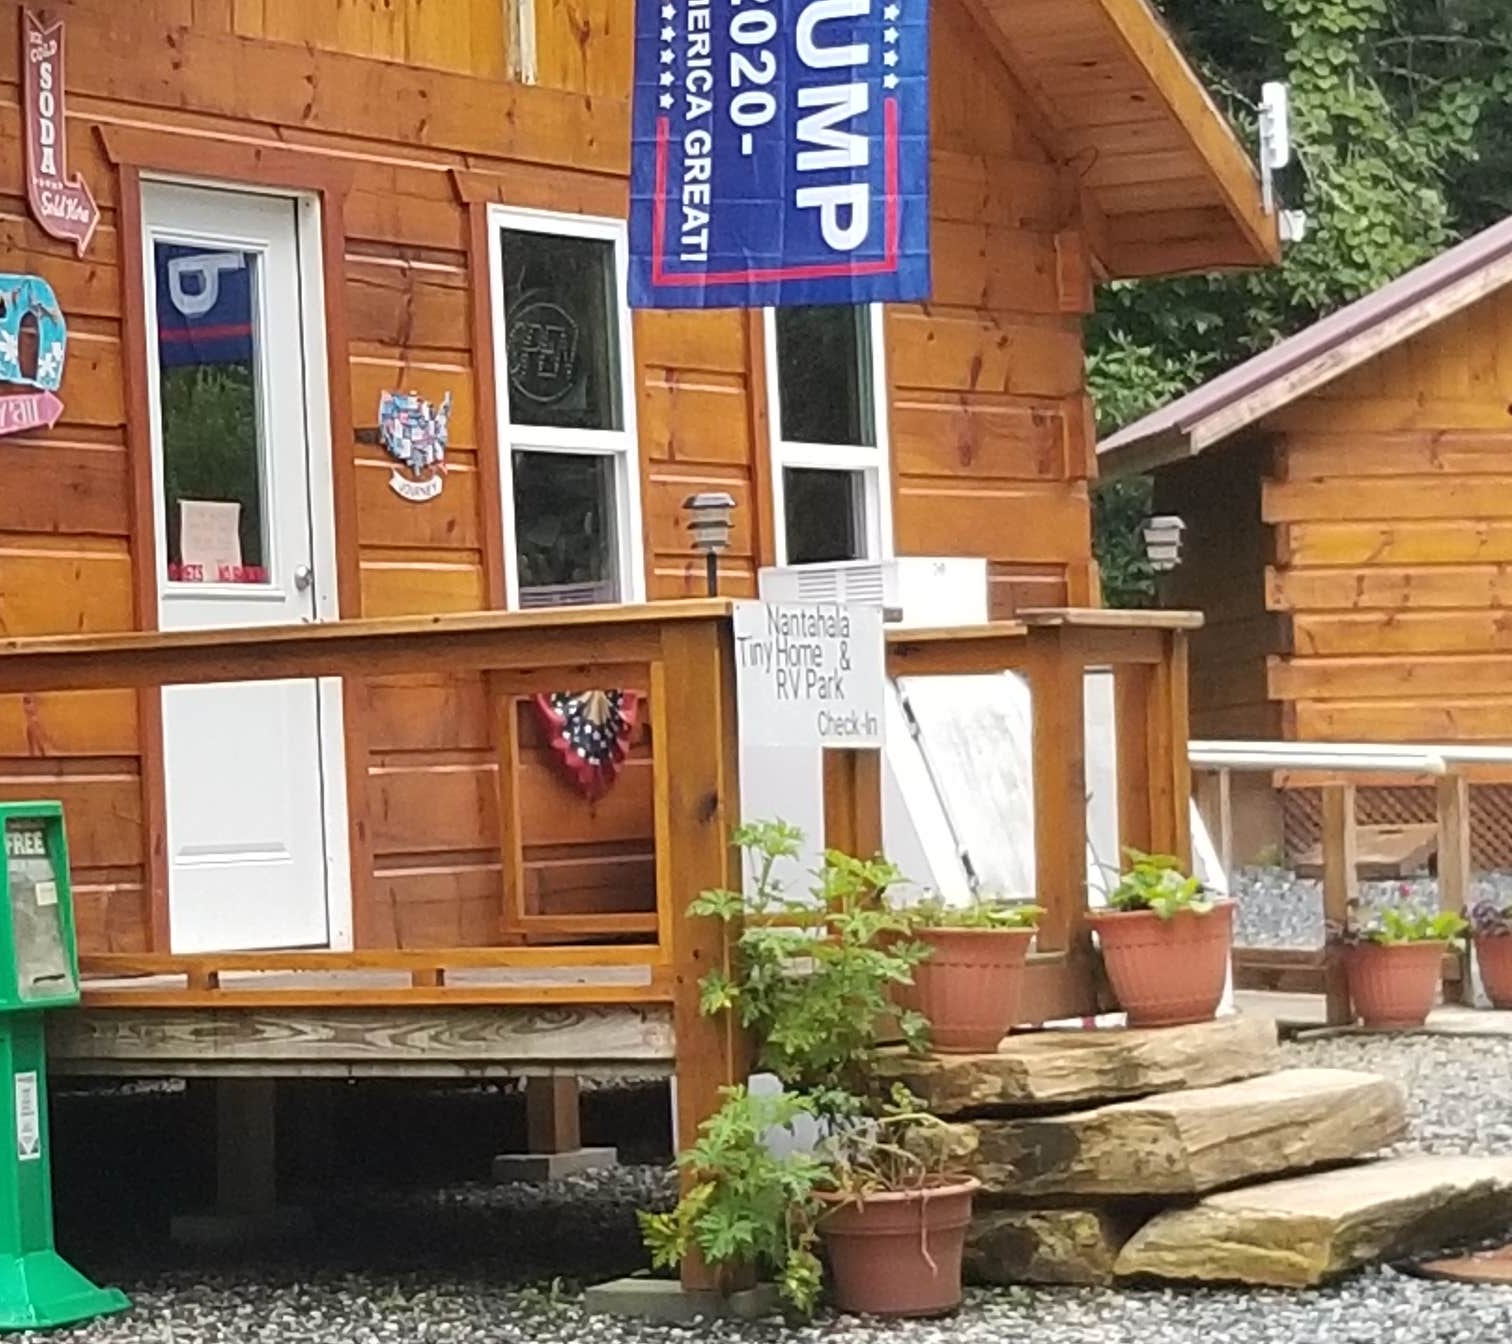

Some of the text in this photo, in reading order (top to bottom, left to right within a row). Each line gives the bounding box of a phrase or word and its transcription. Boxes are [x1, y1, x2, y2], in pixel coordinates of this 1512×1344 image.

[39, 61, 57, 175] SODA
[766, 603, 850, 638] Nantahala
[736, 635, 852, 674] Tiny Home &
[776, 667, 845, 700] RV Park
[818, 710, 878, 737] Check-In
[5, 830, 46, 856] FREE
